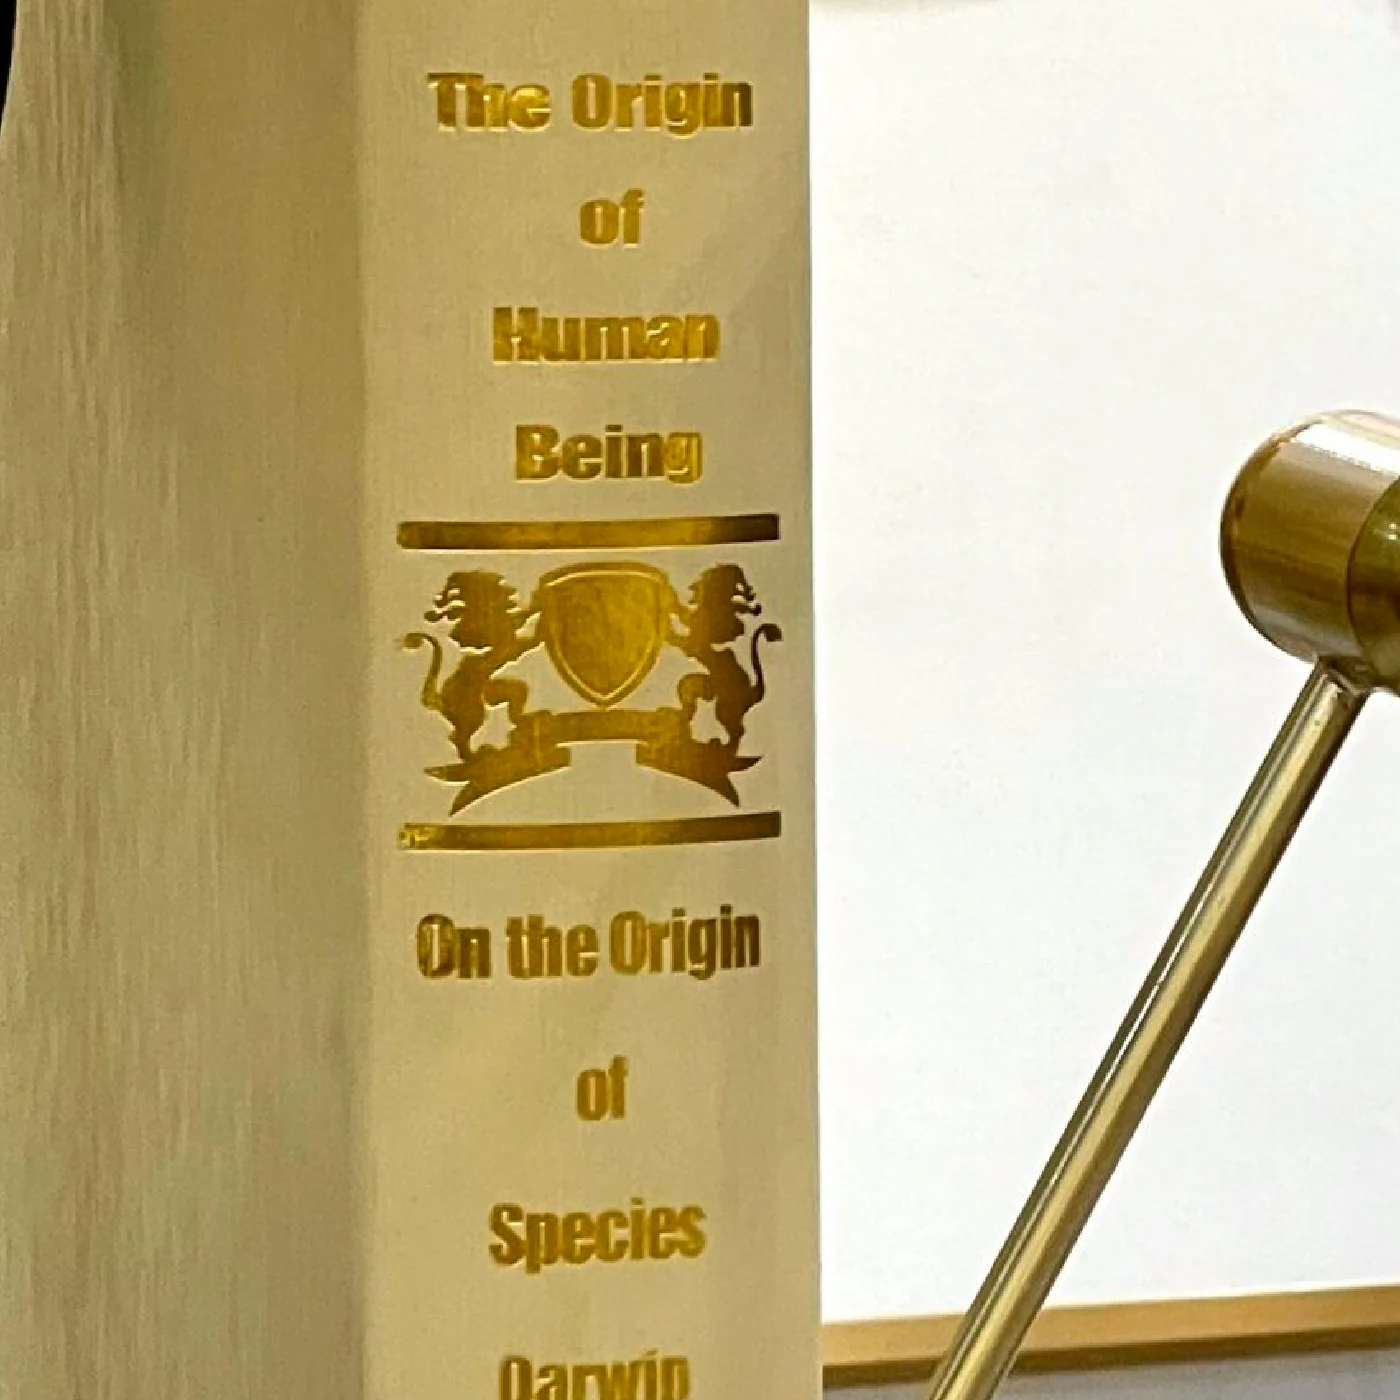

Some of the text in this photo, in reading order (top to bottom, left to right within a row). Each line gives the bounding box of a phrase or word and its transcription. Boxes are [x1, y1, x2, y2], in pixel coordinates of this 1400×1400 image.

[427, 72, 754, 138] The Origin
[579, 188, 645, 247] of
[493, 306, 720, 363] Human
[515, 424, 704, 483] Being
[416, 905, 761, 980] On the Origin
[576, 1054, 629, 1121] of
[490, 1198, 708, 1274] Species
